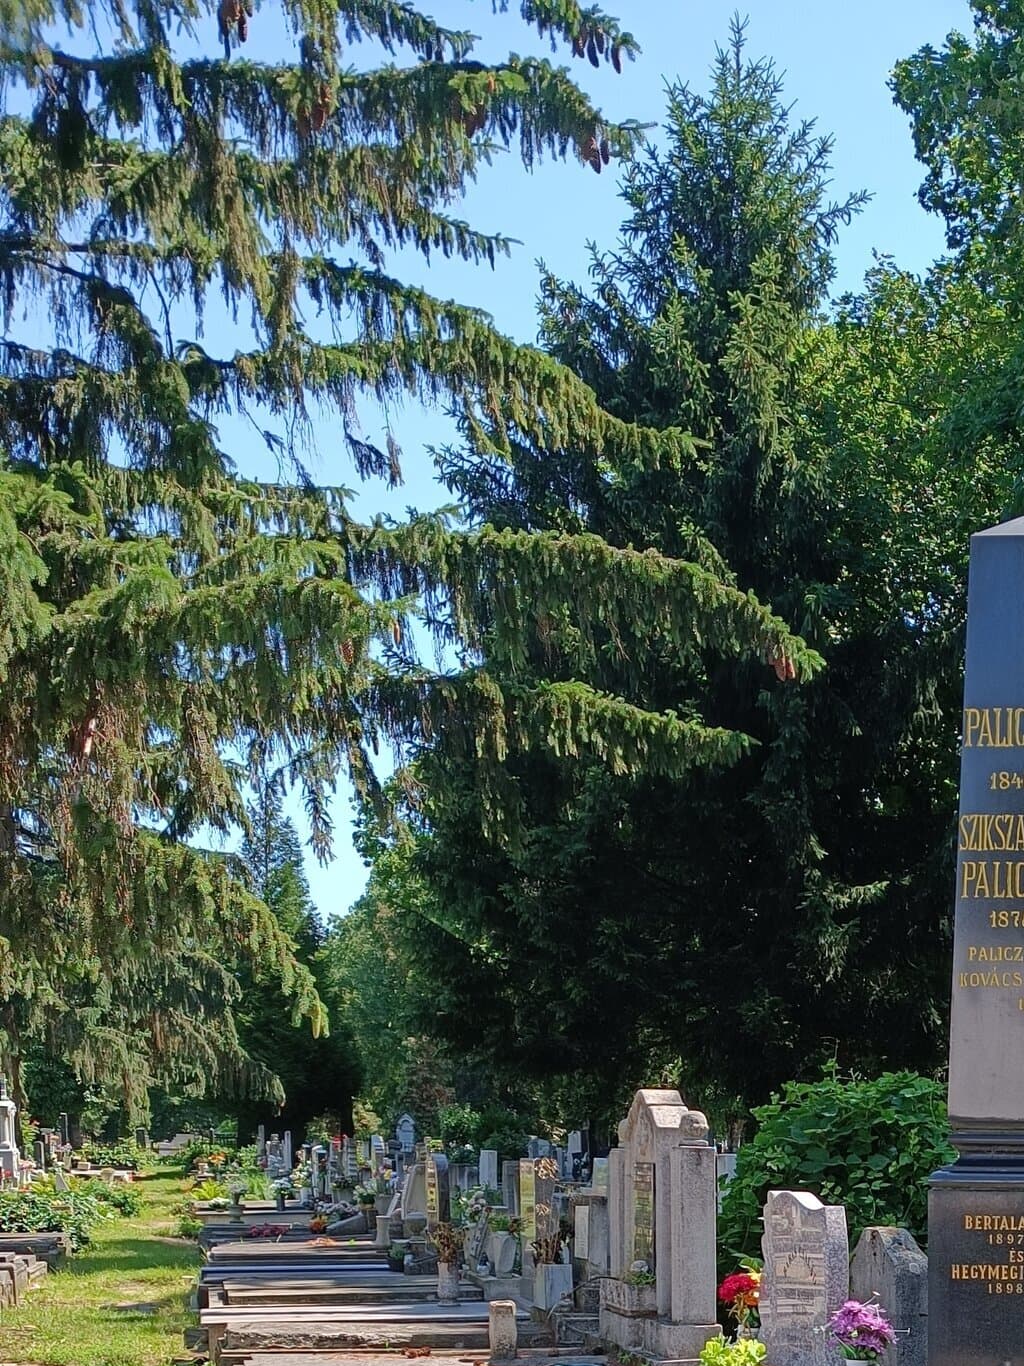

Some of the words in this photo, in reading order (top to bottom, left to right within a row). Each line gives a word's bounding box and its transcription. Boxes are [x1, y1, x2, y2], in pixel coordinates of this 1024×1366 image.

[968, 947, 1023, 961] PALICZ
[960, 968, 1022, 987] KOVÁCS
[987, 1234, 1024, 1244] 1897
[1009, 1248, 1024, 1263] ÉS
[951, 1264, 1024, 1280] HEGYMEGI
[987, 1283, 1023, 1294] 1898
